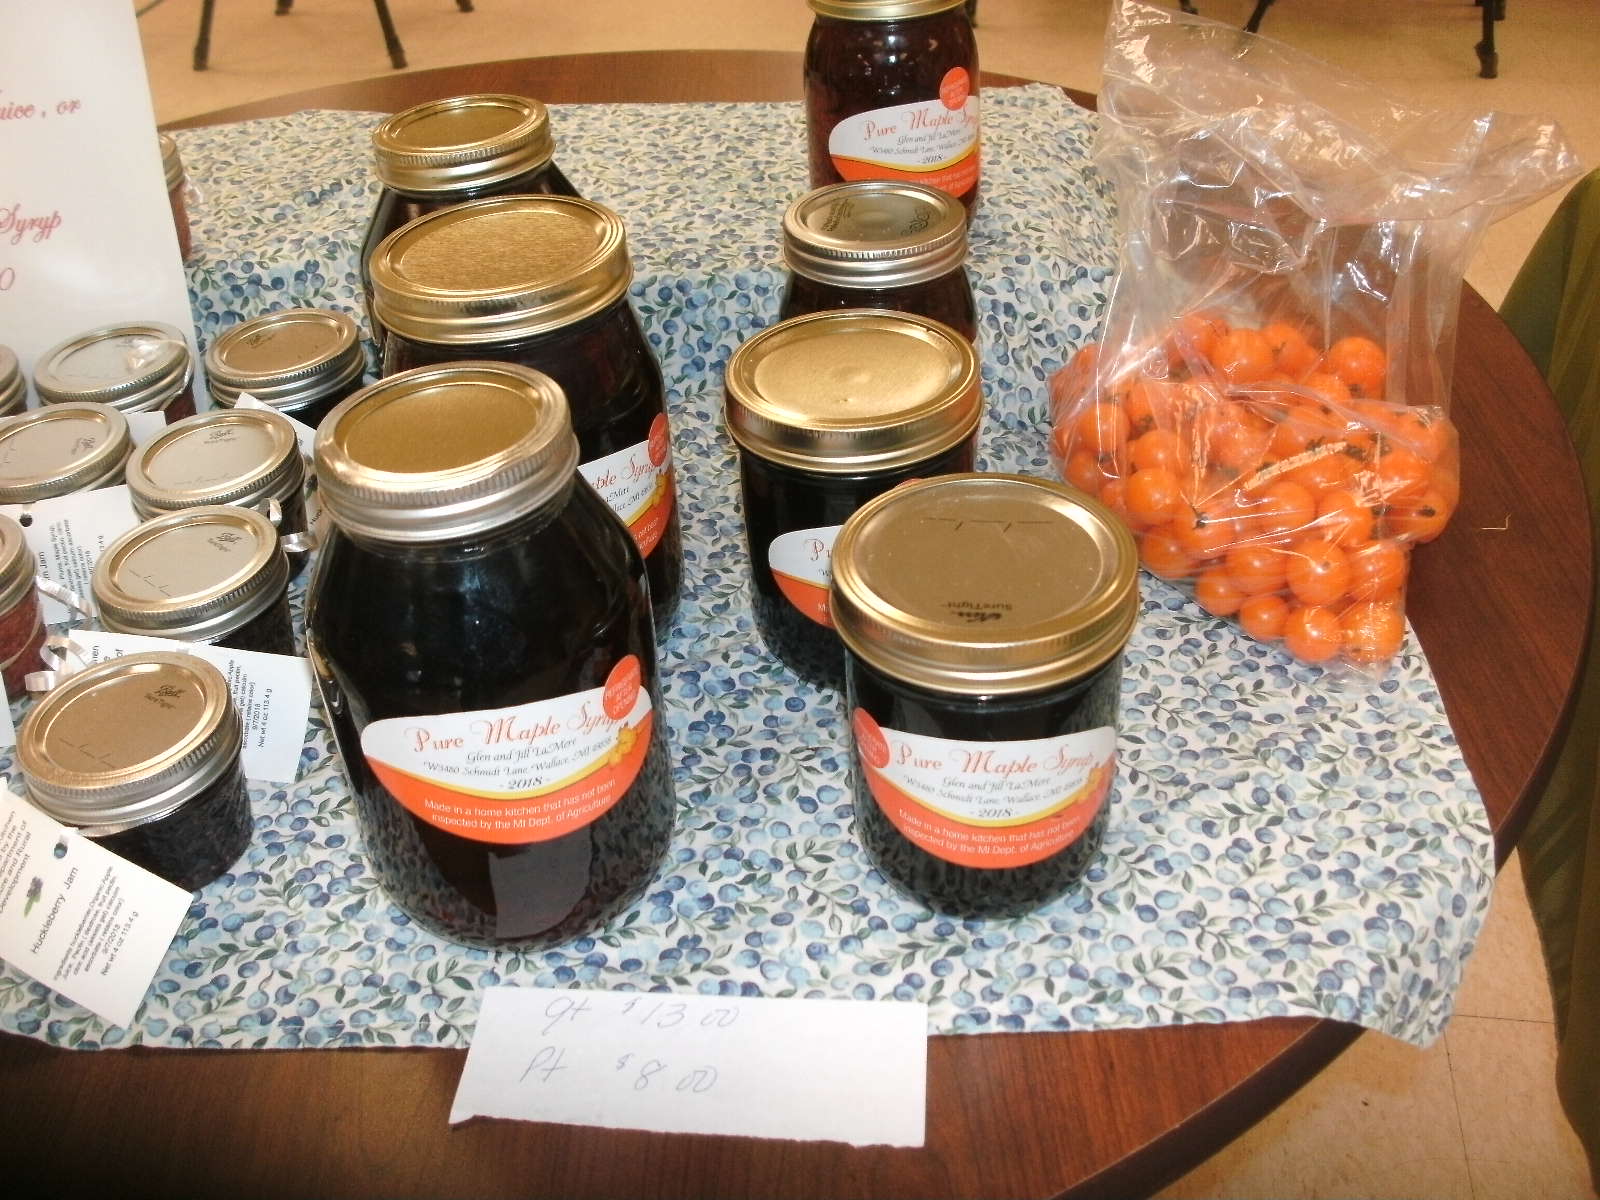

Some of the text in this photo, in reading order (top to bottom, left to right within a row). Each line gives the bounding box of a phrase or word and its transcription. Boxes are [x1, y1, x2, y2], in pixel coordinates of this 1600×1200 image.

[0, 101, 35, 121] uice
[56, 99, 81, 116] or
[864, 119, 897, 141] Pure
[903, 108, 953, 133] Maple
[404, 726, 464, 752] Pure
[470, 715, 561, 745] Maple
[467, 750, 491, 765] Glen
[493, 750, 512, 761] and
[514, 747, 531, 762] Jill
[891, 739, 943, 769] Pure
[947, 748, 1038, 780] Maple
[508, 775, 543, 789] 2018
[968, 780, 986, 792] and
[425, 799, 451, 813] Made
[453, 807, 463, 815] in
[474, 807, 503, 817] home
[505, 805, 541, 817] kitchen
[543, 800, 561, 812] that
[563, 795, 580, 807] has
[582, 787, 596, 799] not
[597, 778, 617, 794] been
[432, 813, 478, 828] inspected
[480, 819, 492, 830] by
[495, 820, 511, 829] the
[514, 818, 526, 828] MI
[556, 811, 566, 822] of
[978, 807, 1012, 818] 2018
[899, 807, 922, 826] Made
[943, 827, 969, 841] home
[971, 832, 1008, 844] kitchen
[946, 840, 958, 851] by
[960, 842, 976, 854] the
[30, 867, 78, 954] Huckleberry Jam
